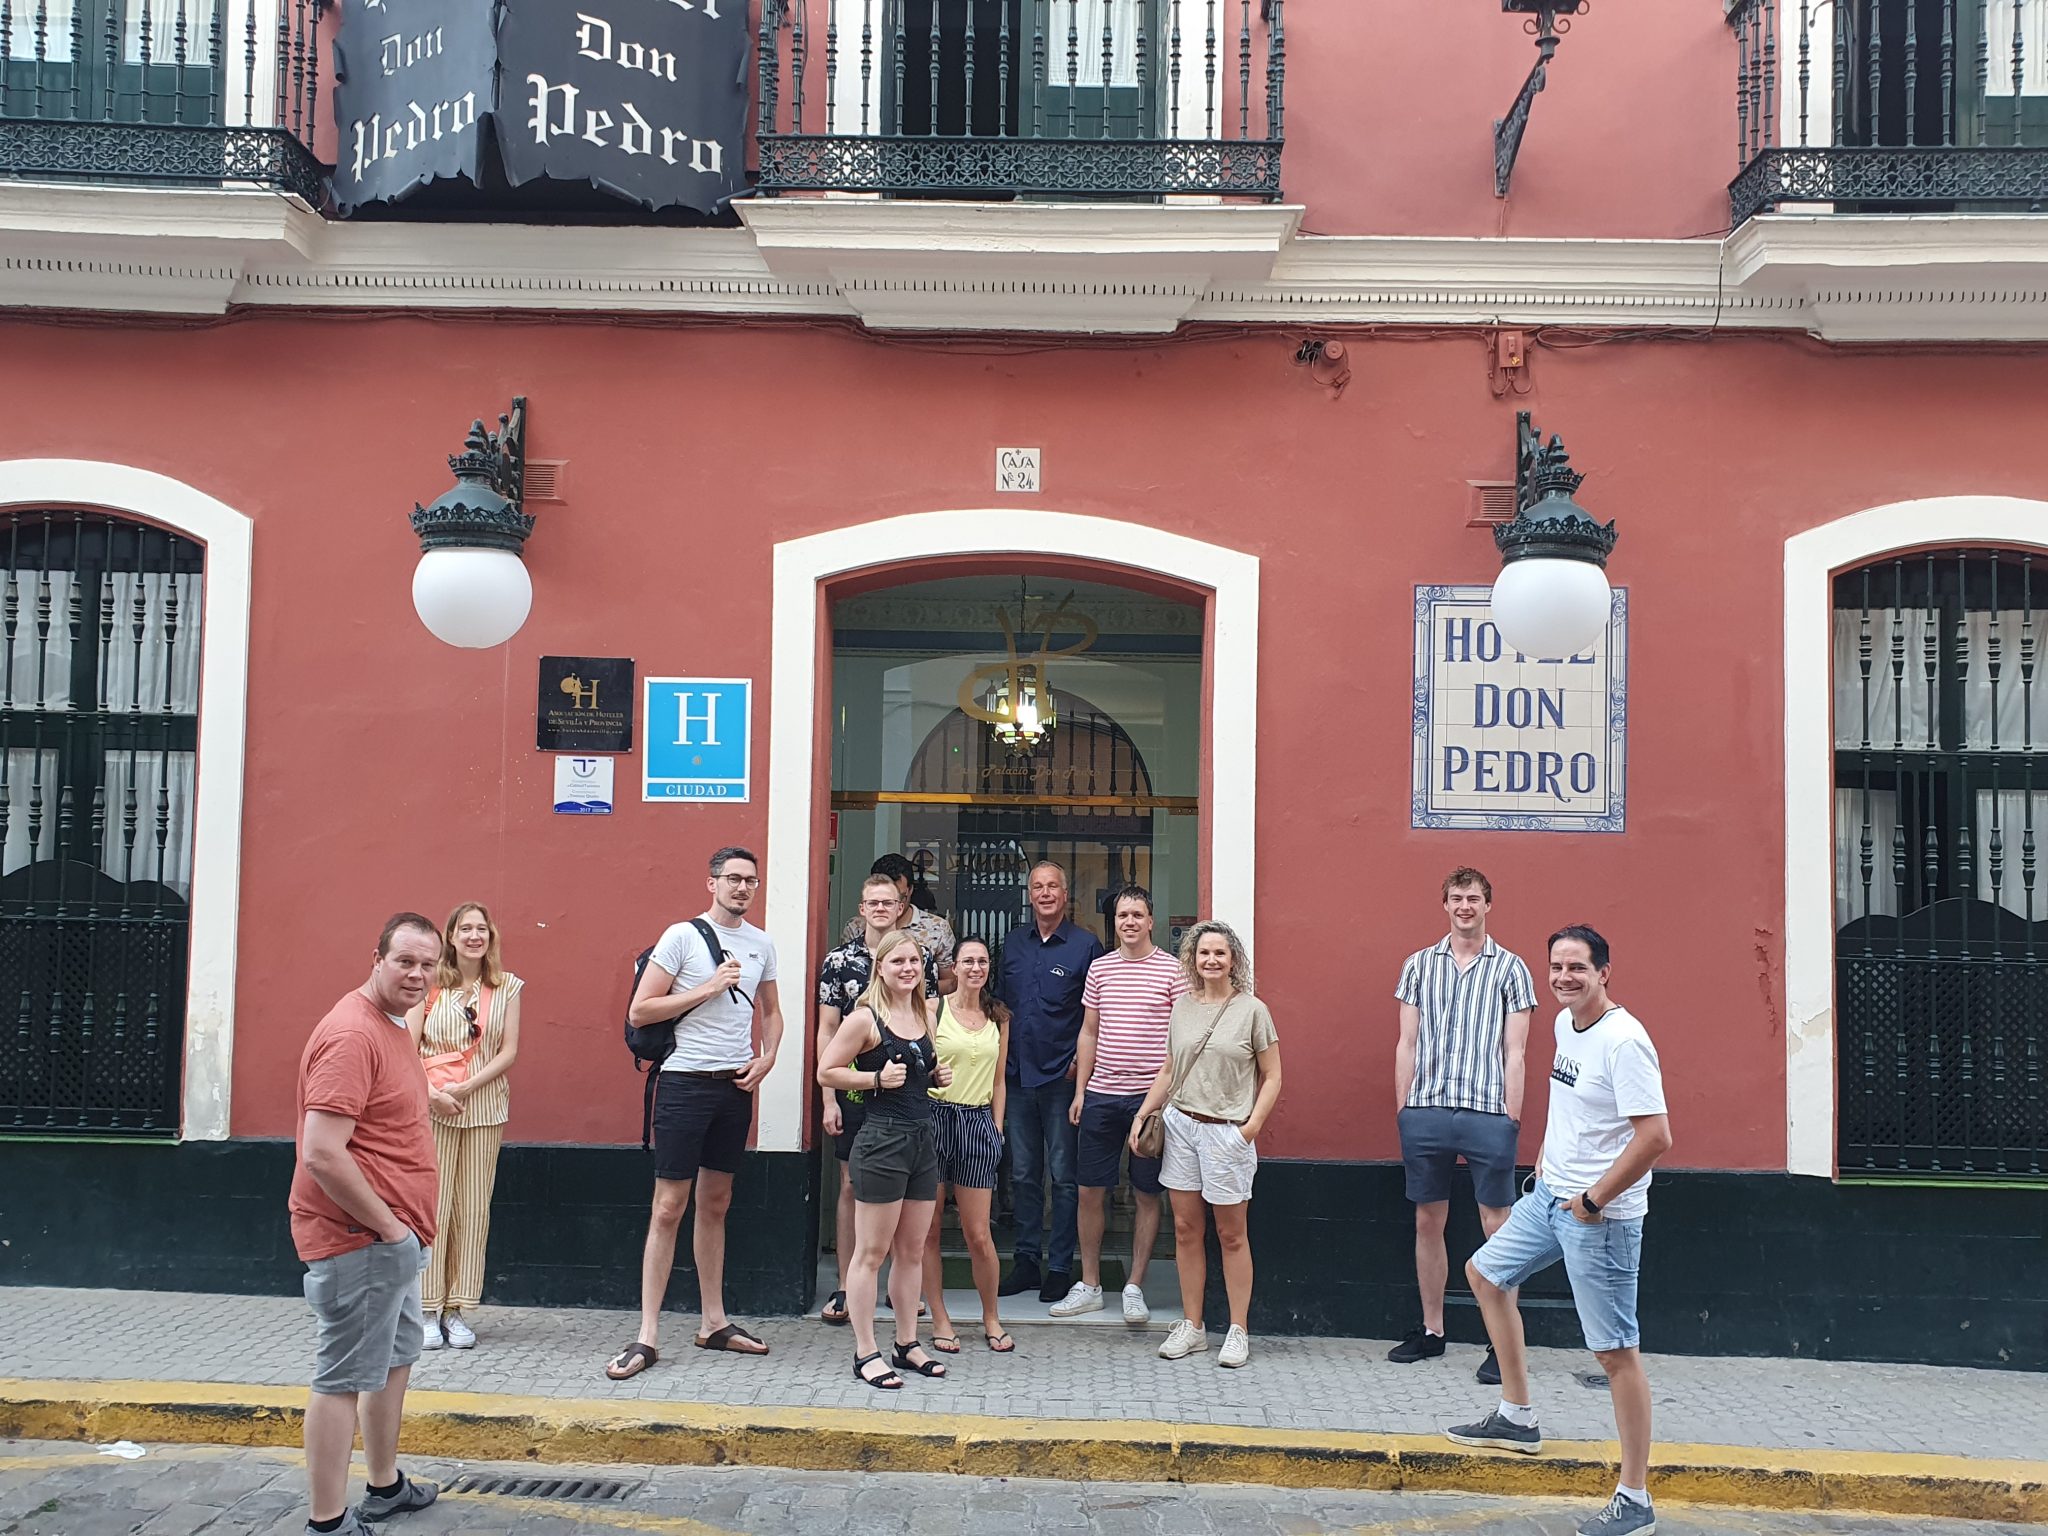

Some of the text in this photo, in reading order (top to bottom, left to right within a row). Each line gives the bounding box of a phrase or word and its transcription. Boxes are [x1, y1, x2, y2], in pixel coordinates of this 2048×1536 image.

[379, 26, 443, 76] Don
[575, 12, 678, 82] Don
[350, 91, 476, 184] Pedro
[527, 73, 724, 174] Pedro
[1017, 471, 1034, 490] 24
[672, 691, 722, 746] H
[1472, 683, 1567, 730] DON
[666, 784, 727, 797] CIUDAD
[1030, 764, 1058, 781] Don
[1441, 745, 1597, 803] PEDRO
[1553, 1053, 1582, 1079] BOSS
